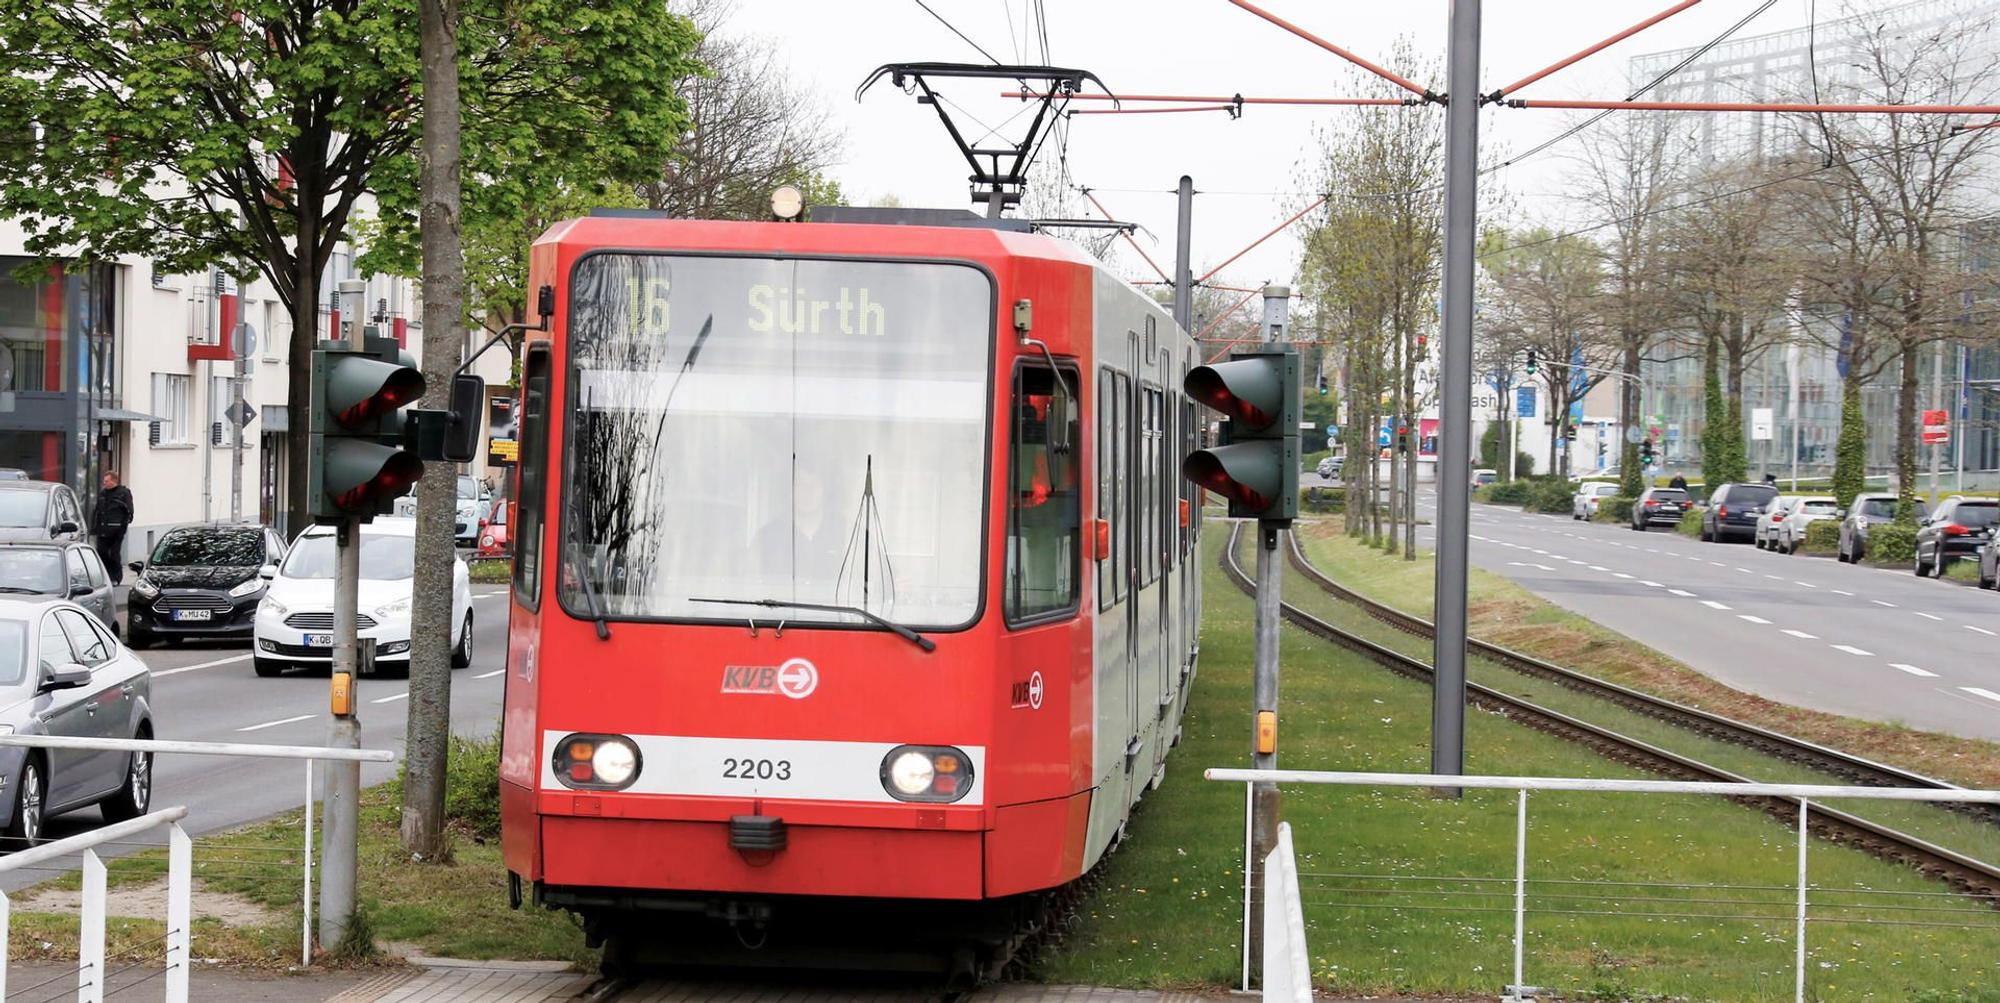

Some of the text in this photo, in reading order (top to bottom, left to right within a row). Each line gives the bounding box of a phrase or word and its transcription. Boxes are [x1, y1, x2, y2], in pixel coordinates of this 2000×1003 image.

[626, 277, 885, 335] 16 Sürth
[723, 666, 777, 690] KVB
[1011, 681, 1030, 705] KVB
[723, 758, 791, 780] 2203
